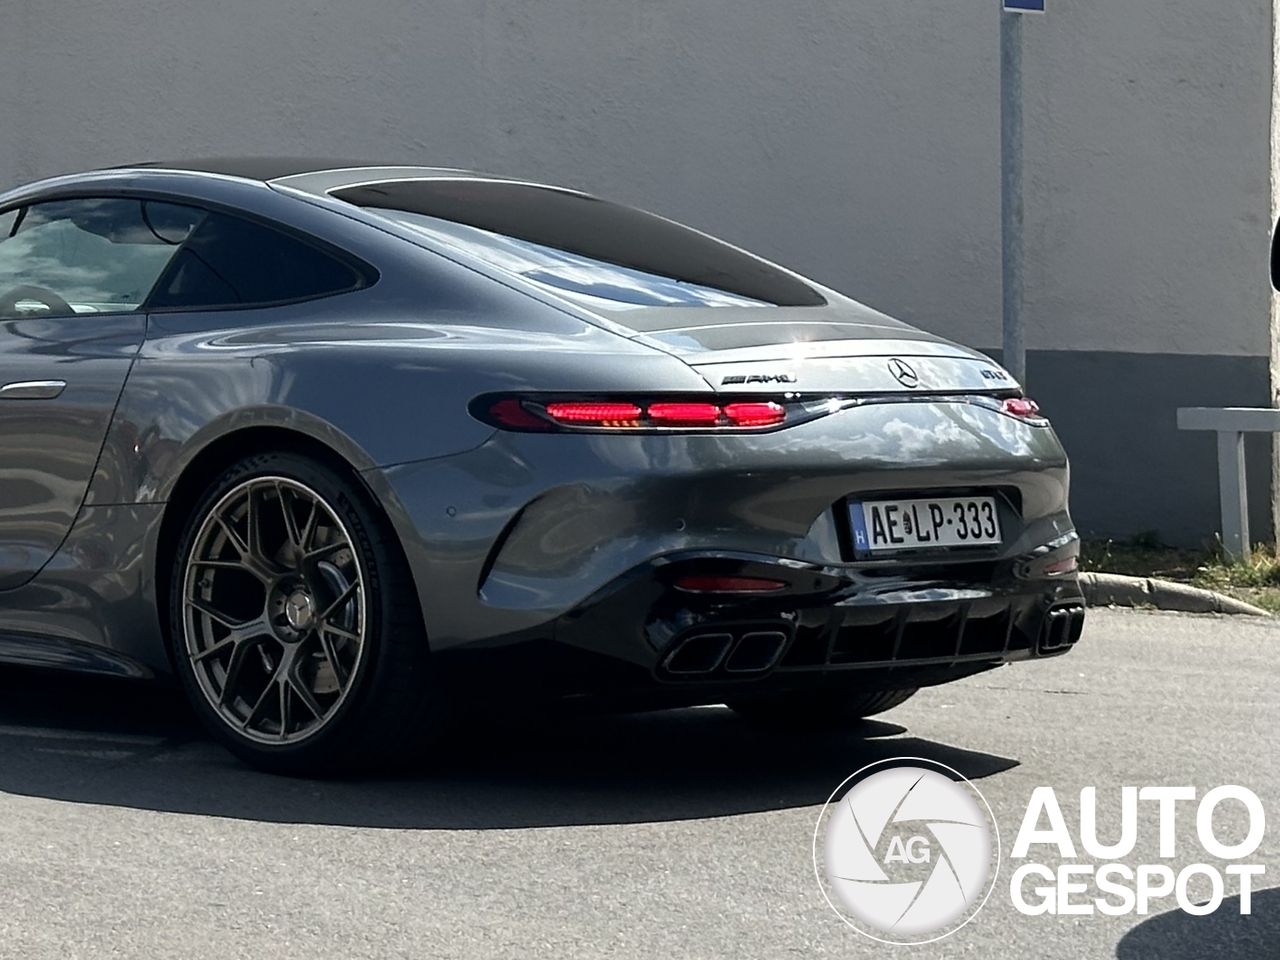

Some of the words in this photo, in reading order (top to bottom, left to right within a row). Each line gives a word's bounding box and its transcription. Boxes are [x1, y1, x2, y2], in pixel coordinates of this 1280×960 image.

[871, 505, 904, 544] AE
[911, 501, 996, 542] LP-333
[855, 530, 865, 544] H
